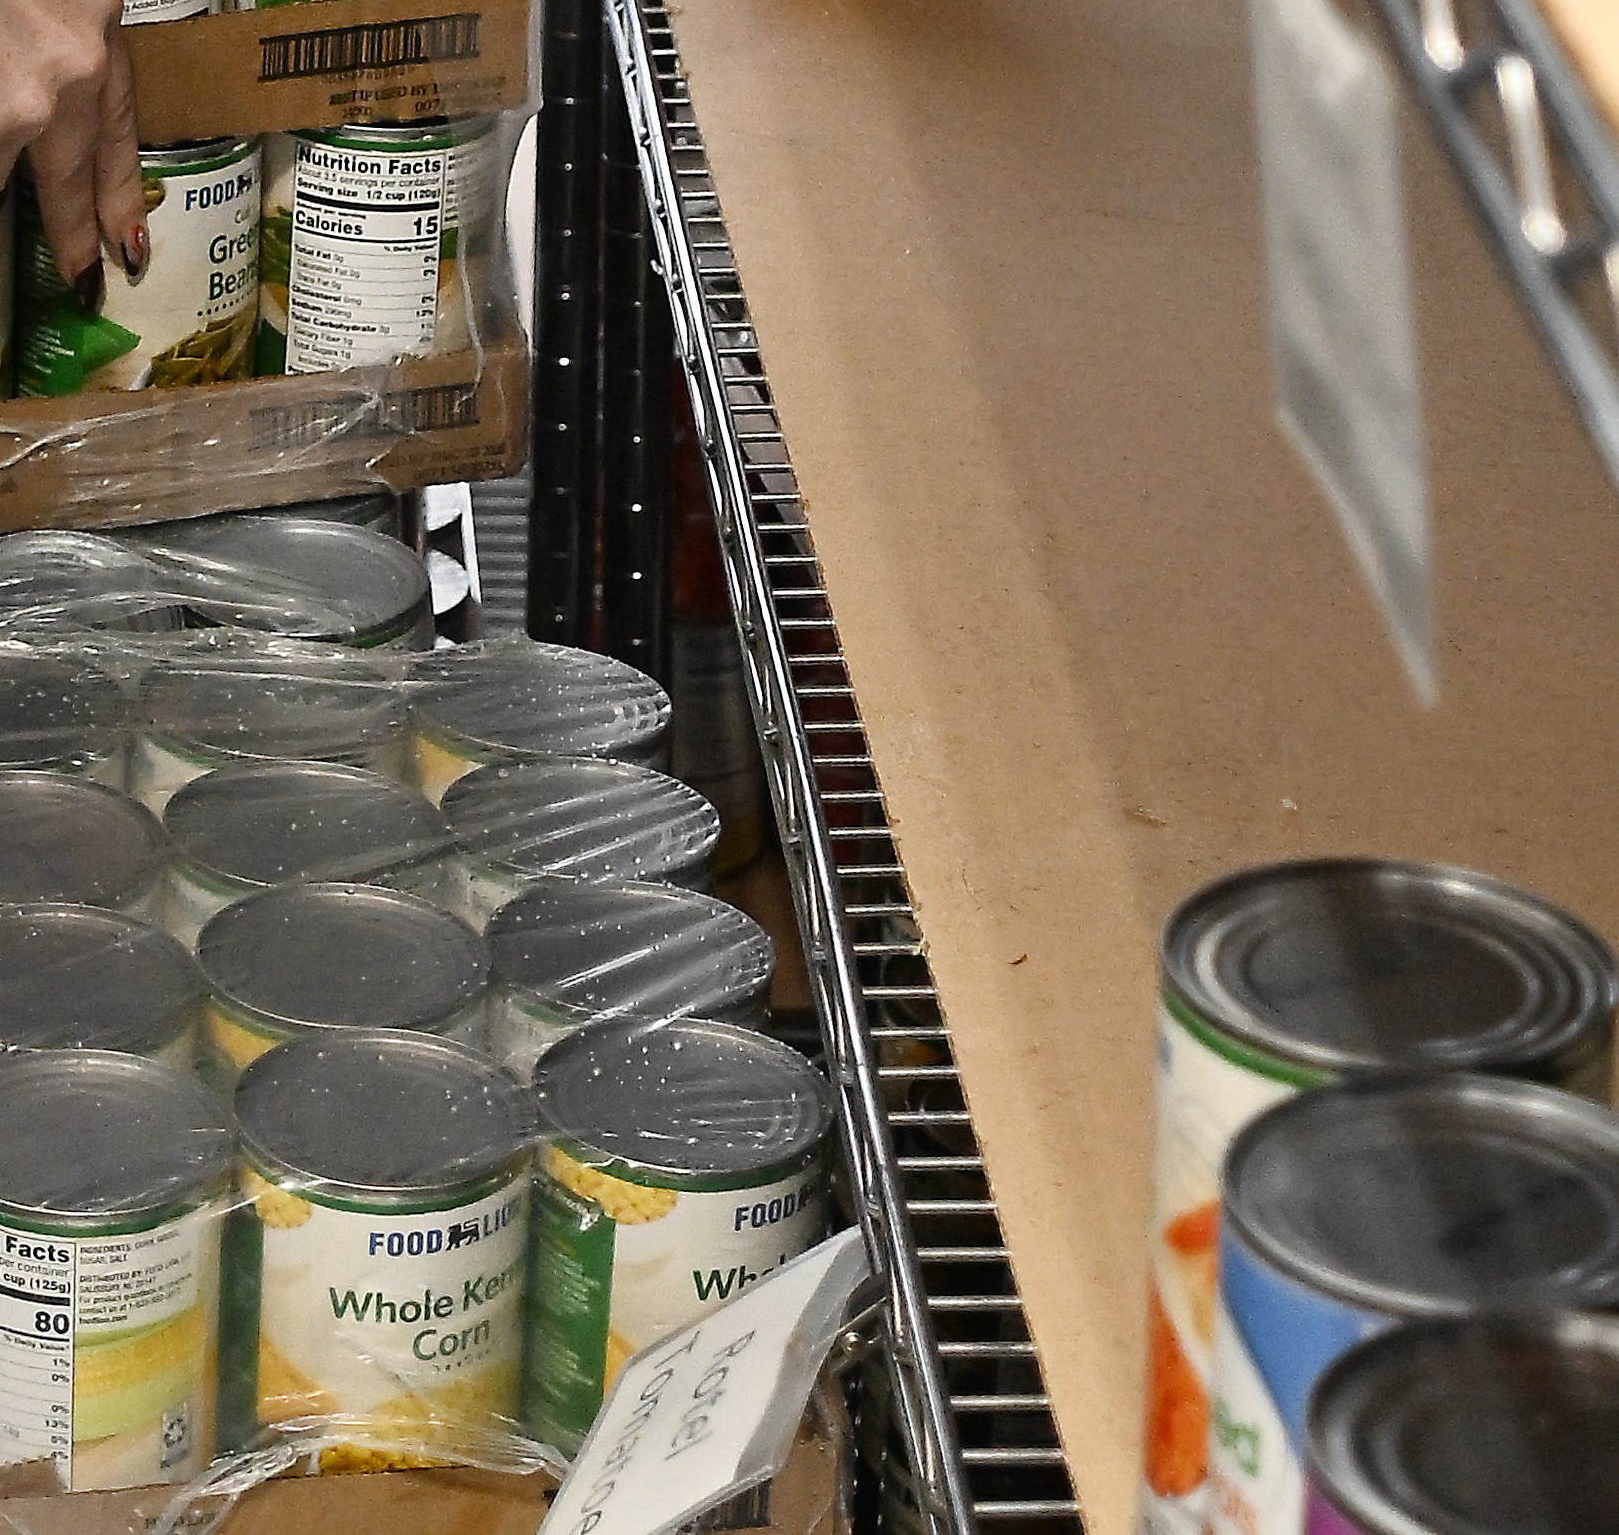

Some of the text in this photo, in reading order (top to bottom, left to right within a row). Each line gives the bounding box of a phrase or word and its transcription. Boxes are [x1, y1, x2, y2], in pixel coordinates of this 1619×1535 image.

[298, 145, 441, 175] Nutrition Facts
[185, 179, 234, 211] FOOD
[297, 177, 333, 195] Serving
[337, 186, 358, 197] size
[365, 189, 382, 199] 1/2
[385, 190, 405, 201] cup
[295, 209, 363, 236] Calories
[413, 215, 438, 236] 15
[294, 243, 314, 256] Total
[291, 311, 377, 333] Total Carbohydrate
[734, 1194, 796, 1231] FOOD
[5, 1235, 70, 1263] Facts
[369, 1229, 443, 1256] FOOD
[3, 1271, 26, 1286] cup
[30, 1278, 71, 1294] (125g)
[17, 1263, 69, 1277] container
[329, 1286, 453, 1324] Whole
[35, 1311, 70, 1334] 80
[412, 1319, 490, 1361] Corn
[53, 1358, 70, 1367] 1%
